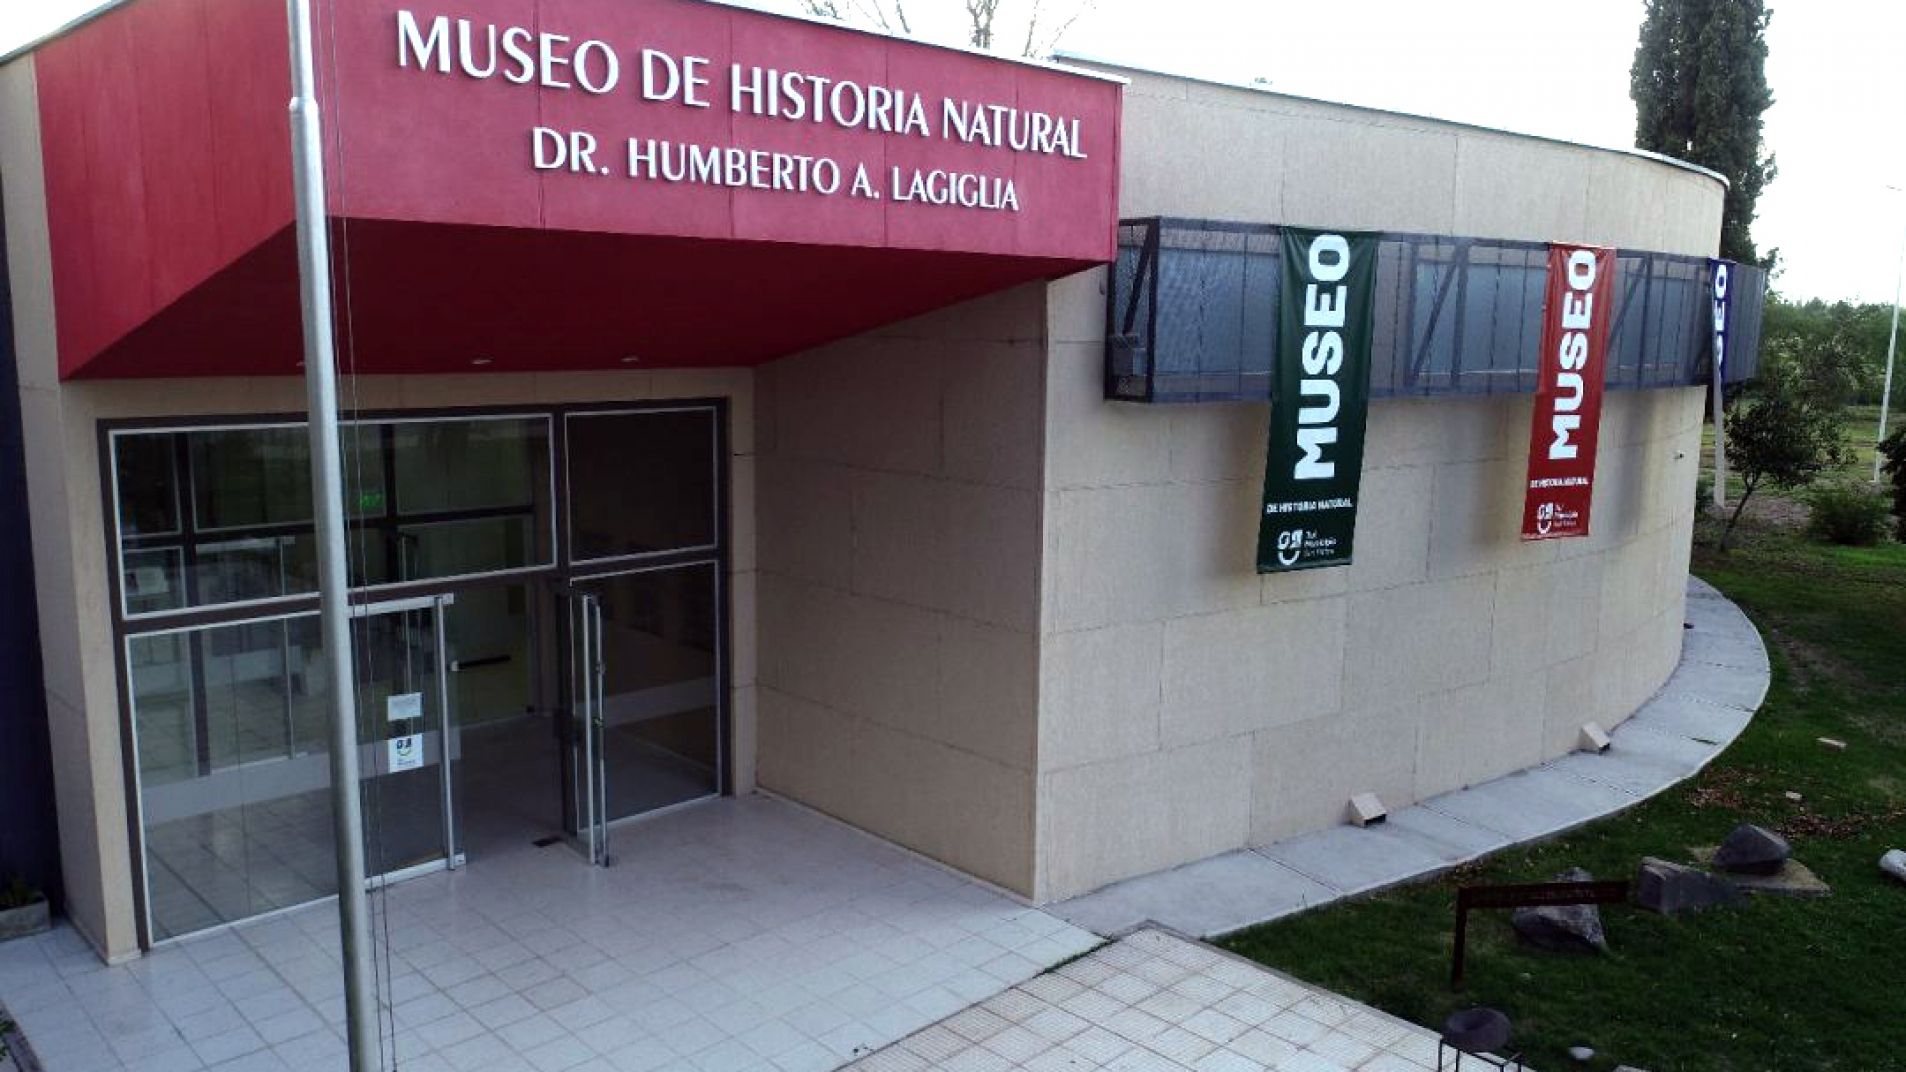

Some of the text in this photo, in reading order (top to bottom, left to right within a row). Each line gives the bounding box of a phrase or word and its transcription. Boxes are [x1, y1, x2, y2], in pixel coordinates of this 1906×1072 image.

[396, 10, 1088, 159] MUSEO DE HISTORIA NATURAL
[532, 126, 1020, 211] DR. HUMBERTO A. LAGIGLIA
[1293, 234, 1350, 480] MUSEO
[1548, 250, 1597, 460] MUSEO
